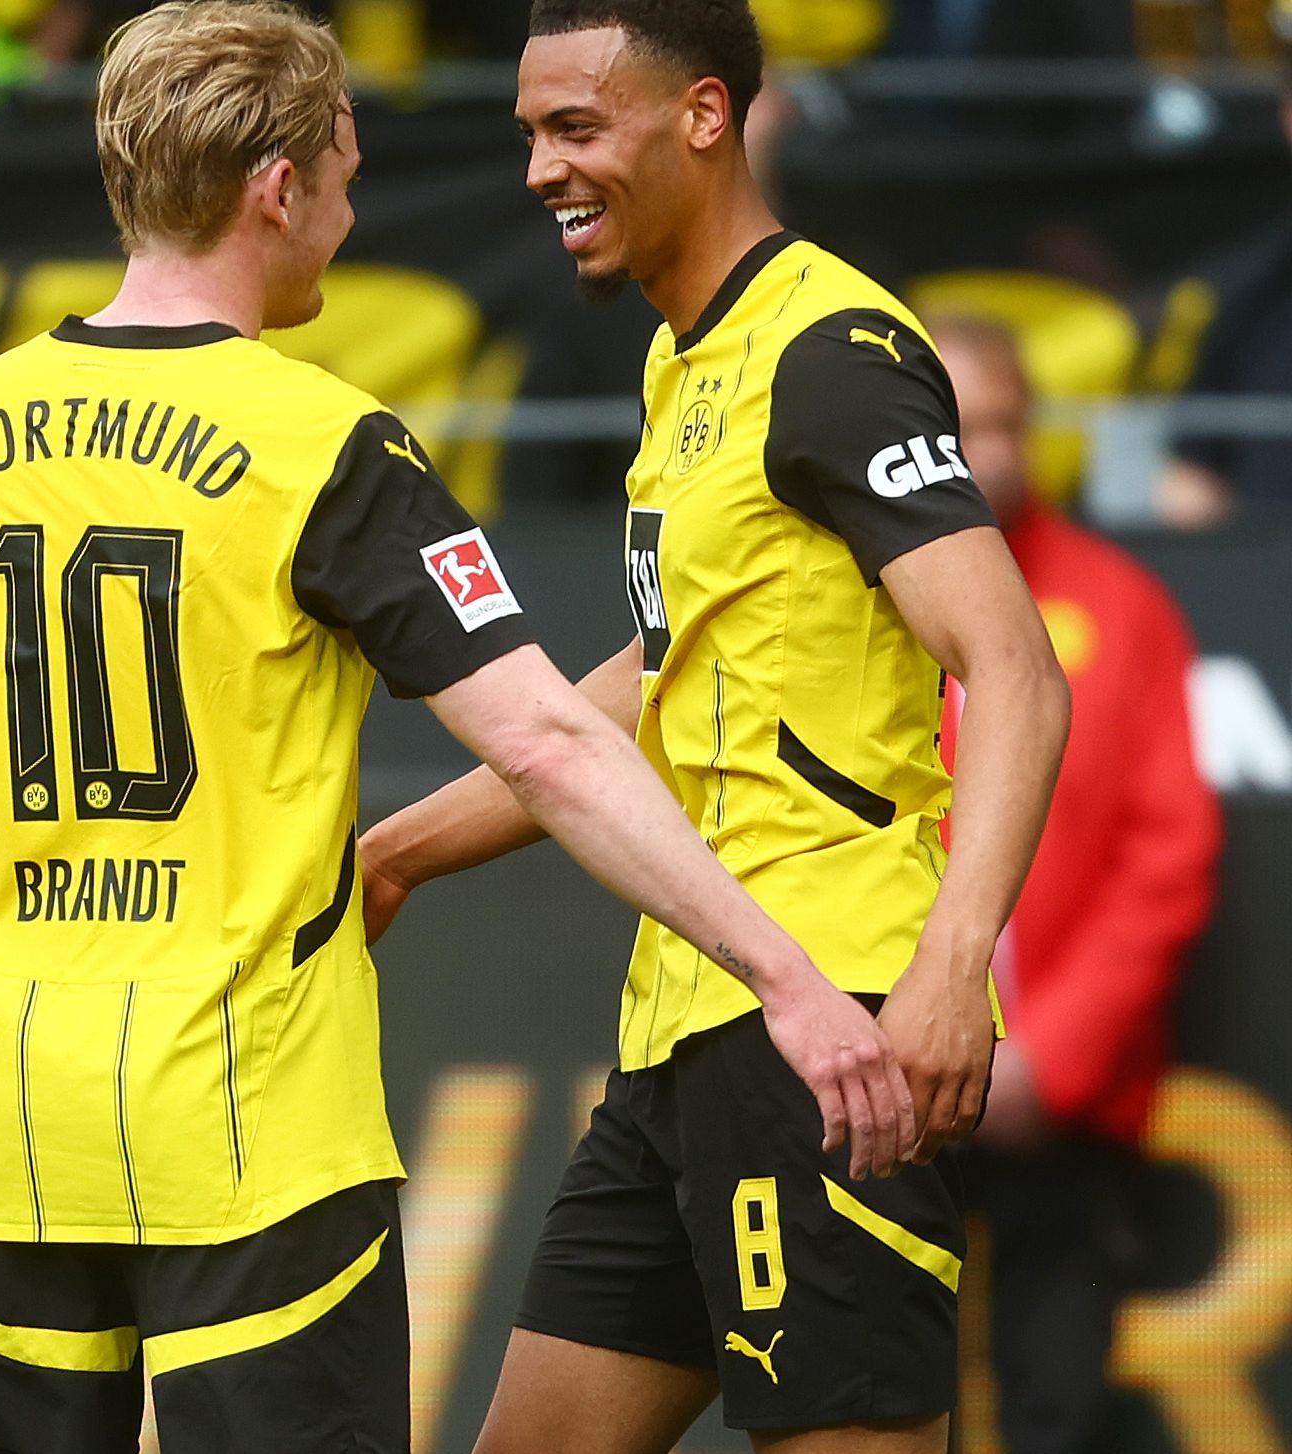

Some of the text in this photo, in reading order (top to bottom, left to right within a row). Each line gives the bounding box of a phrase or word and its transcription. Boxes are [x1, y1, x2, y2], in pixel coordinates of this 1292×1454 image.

[680, 408, 708, 453] BVB
[867, 433, 972, 498] GLS
[27, 785, 46, 802] BVB
[89, 783, 109, 801] BVB
[15, 859, 186, 922] BRANDT
[732, 1176, 787, 1311] 8
